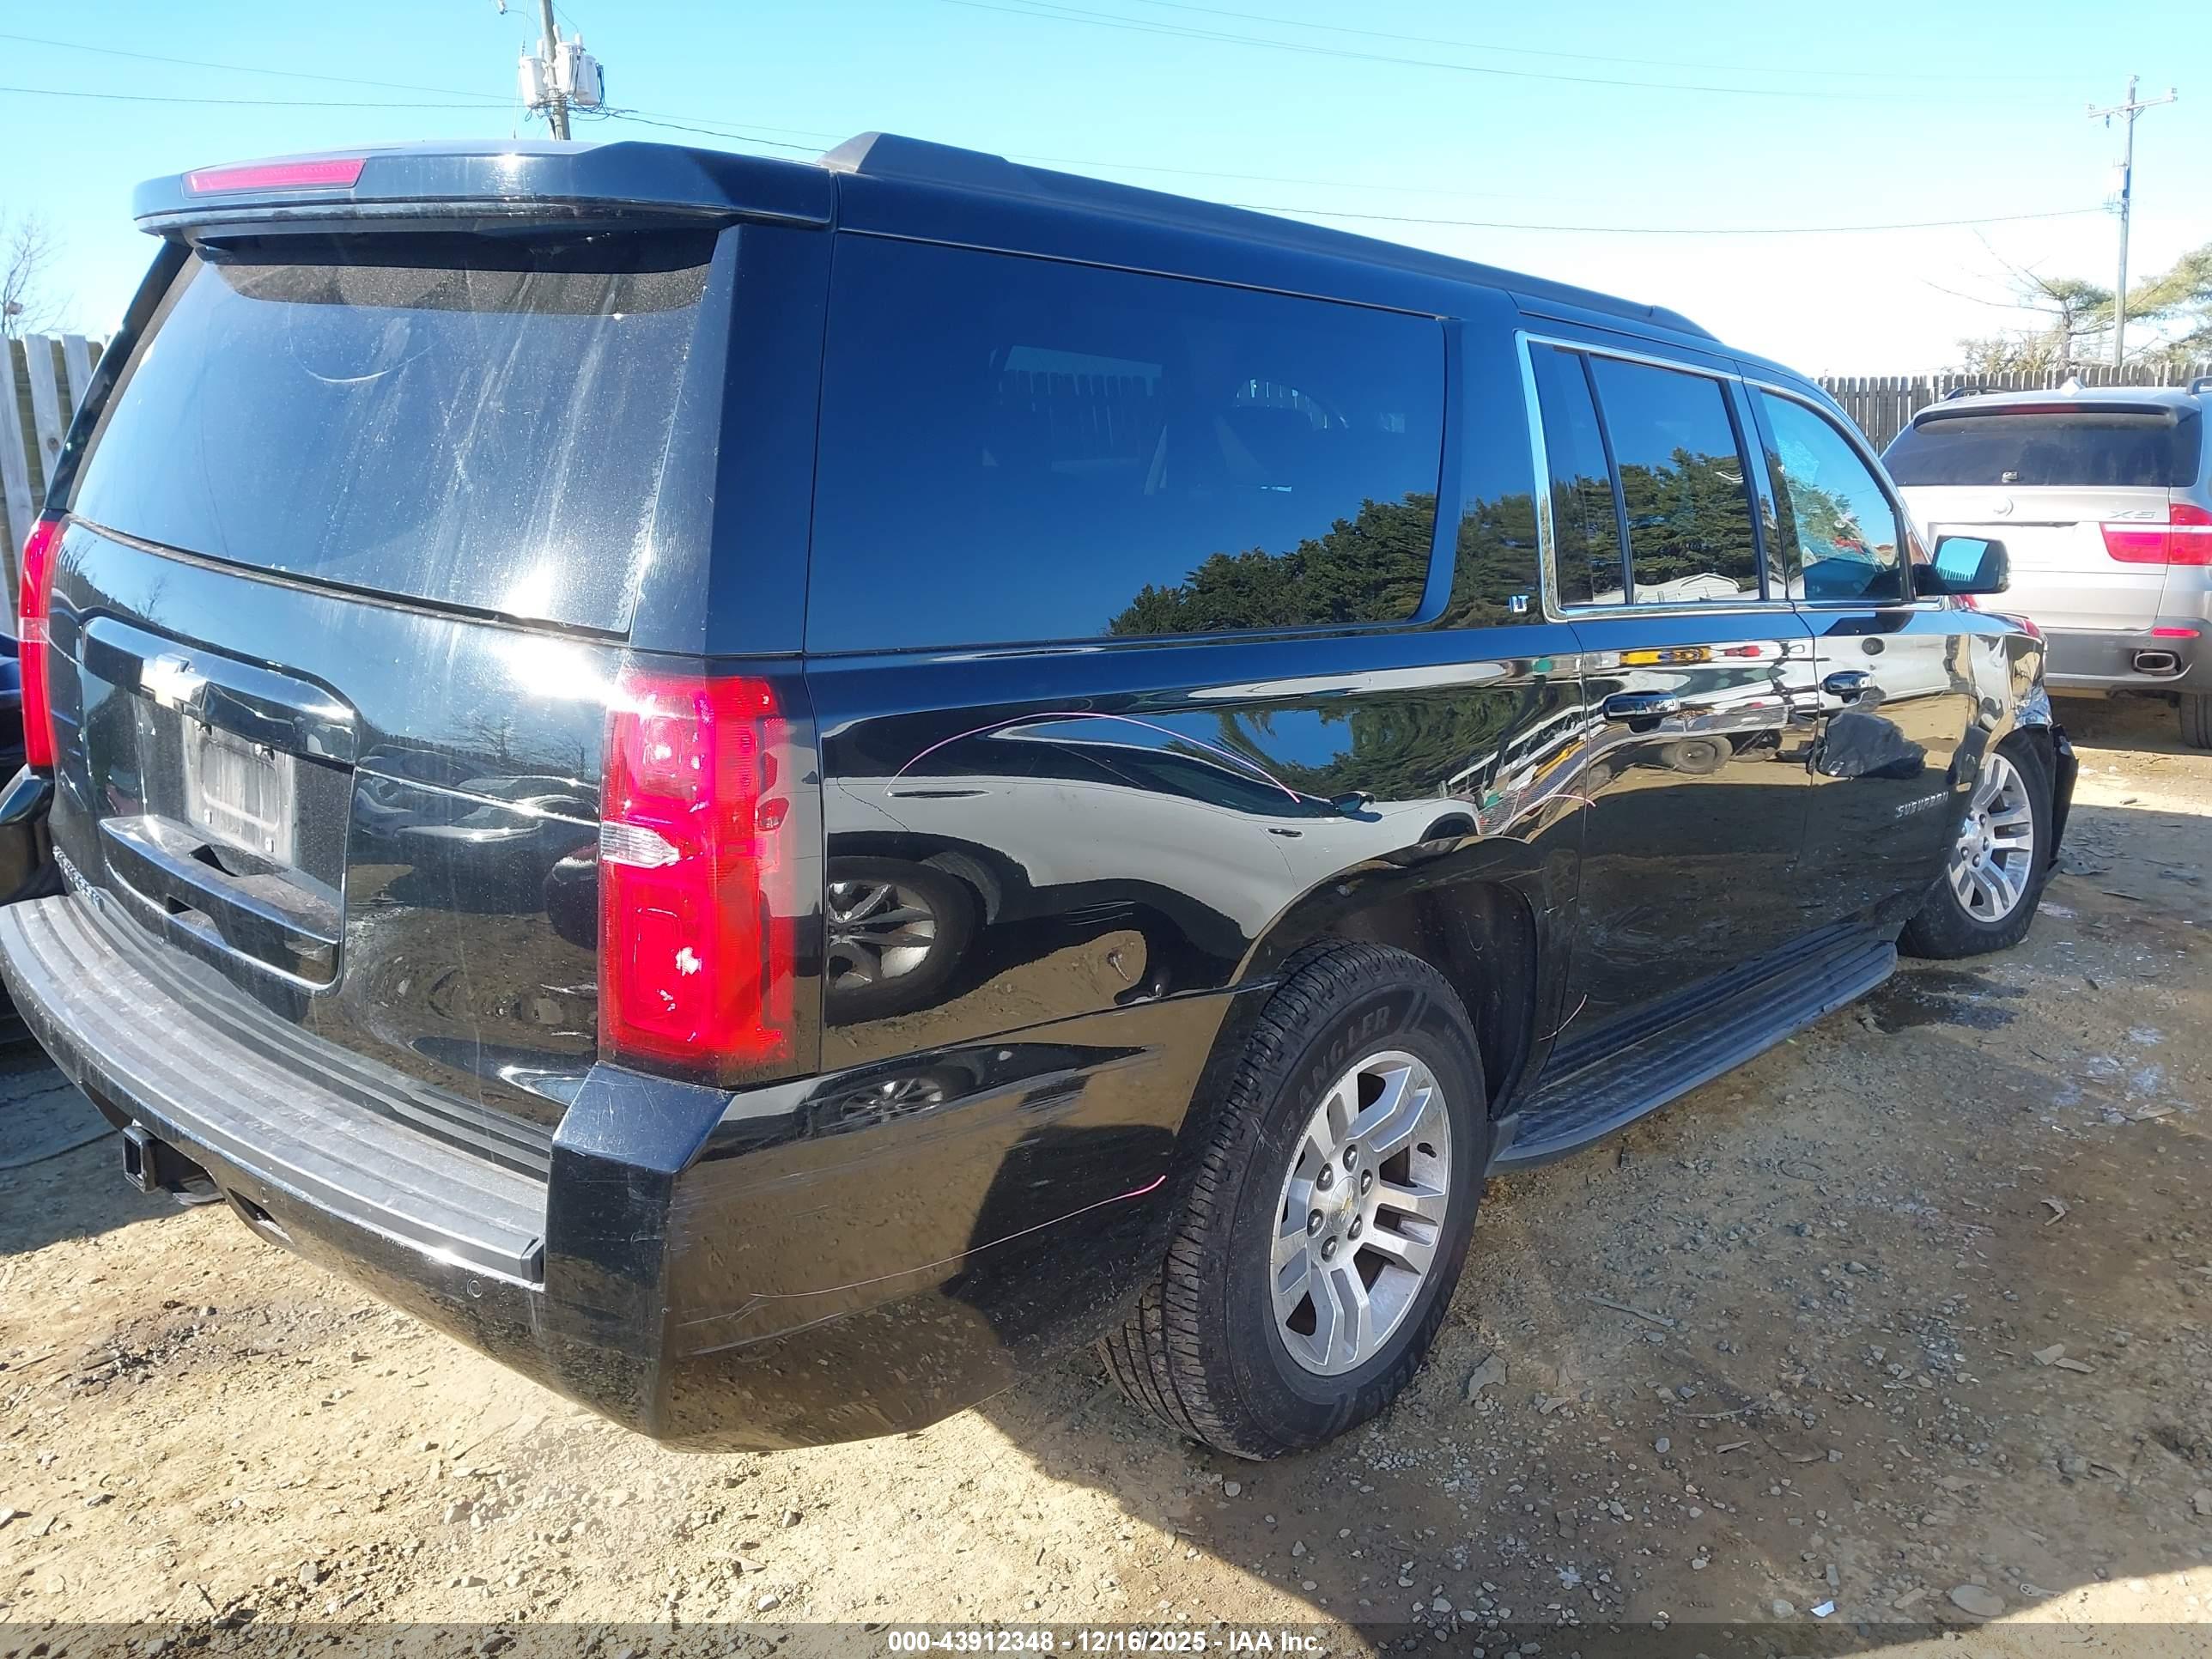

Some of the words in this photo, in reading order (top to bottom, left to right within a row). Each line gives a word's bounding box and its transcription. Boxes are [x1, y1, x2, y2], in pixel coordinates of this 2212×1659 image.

[2108, 509, 2157, 520] X5
[1509, 595, 1529, 612] LT
[1895, 790, 1949, 818] SUBURBAN
